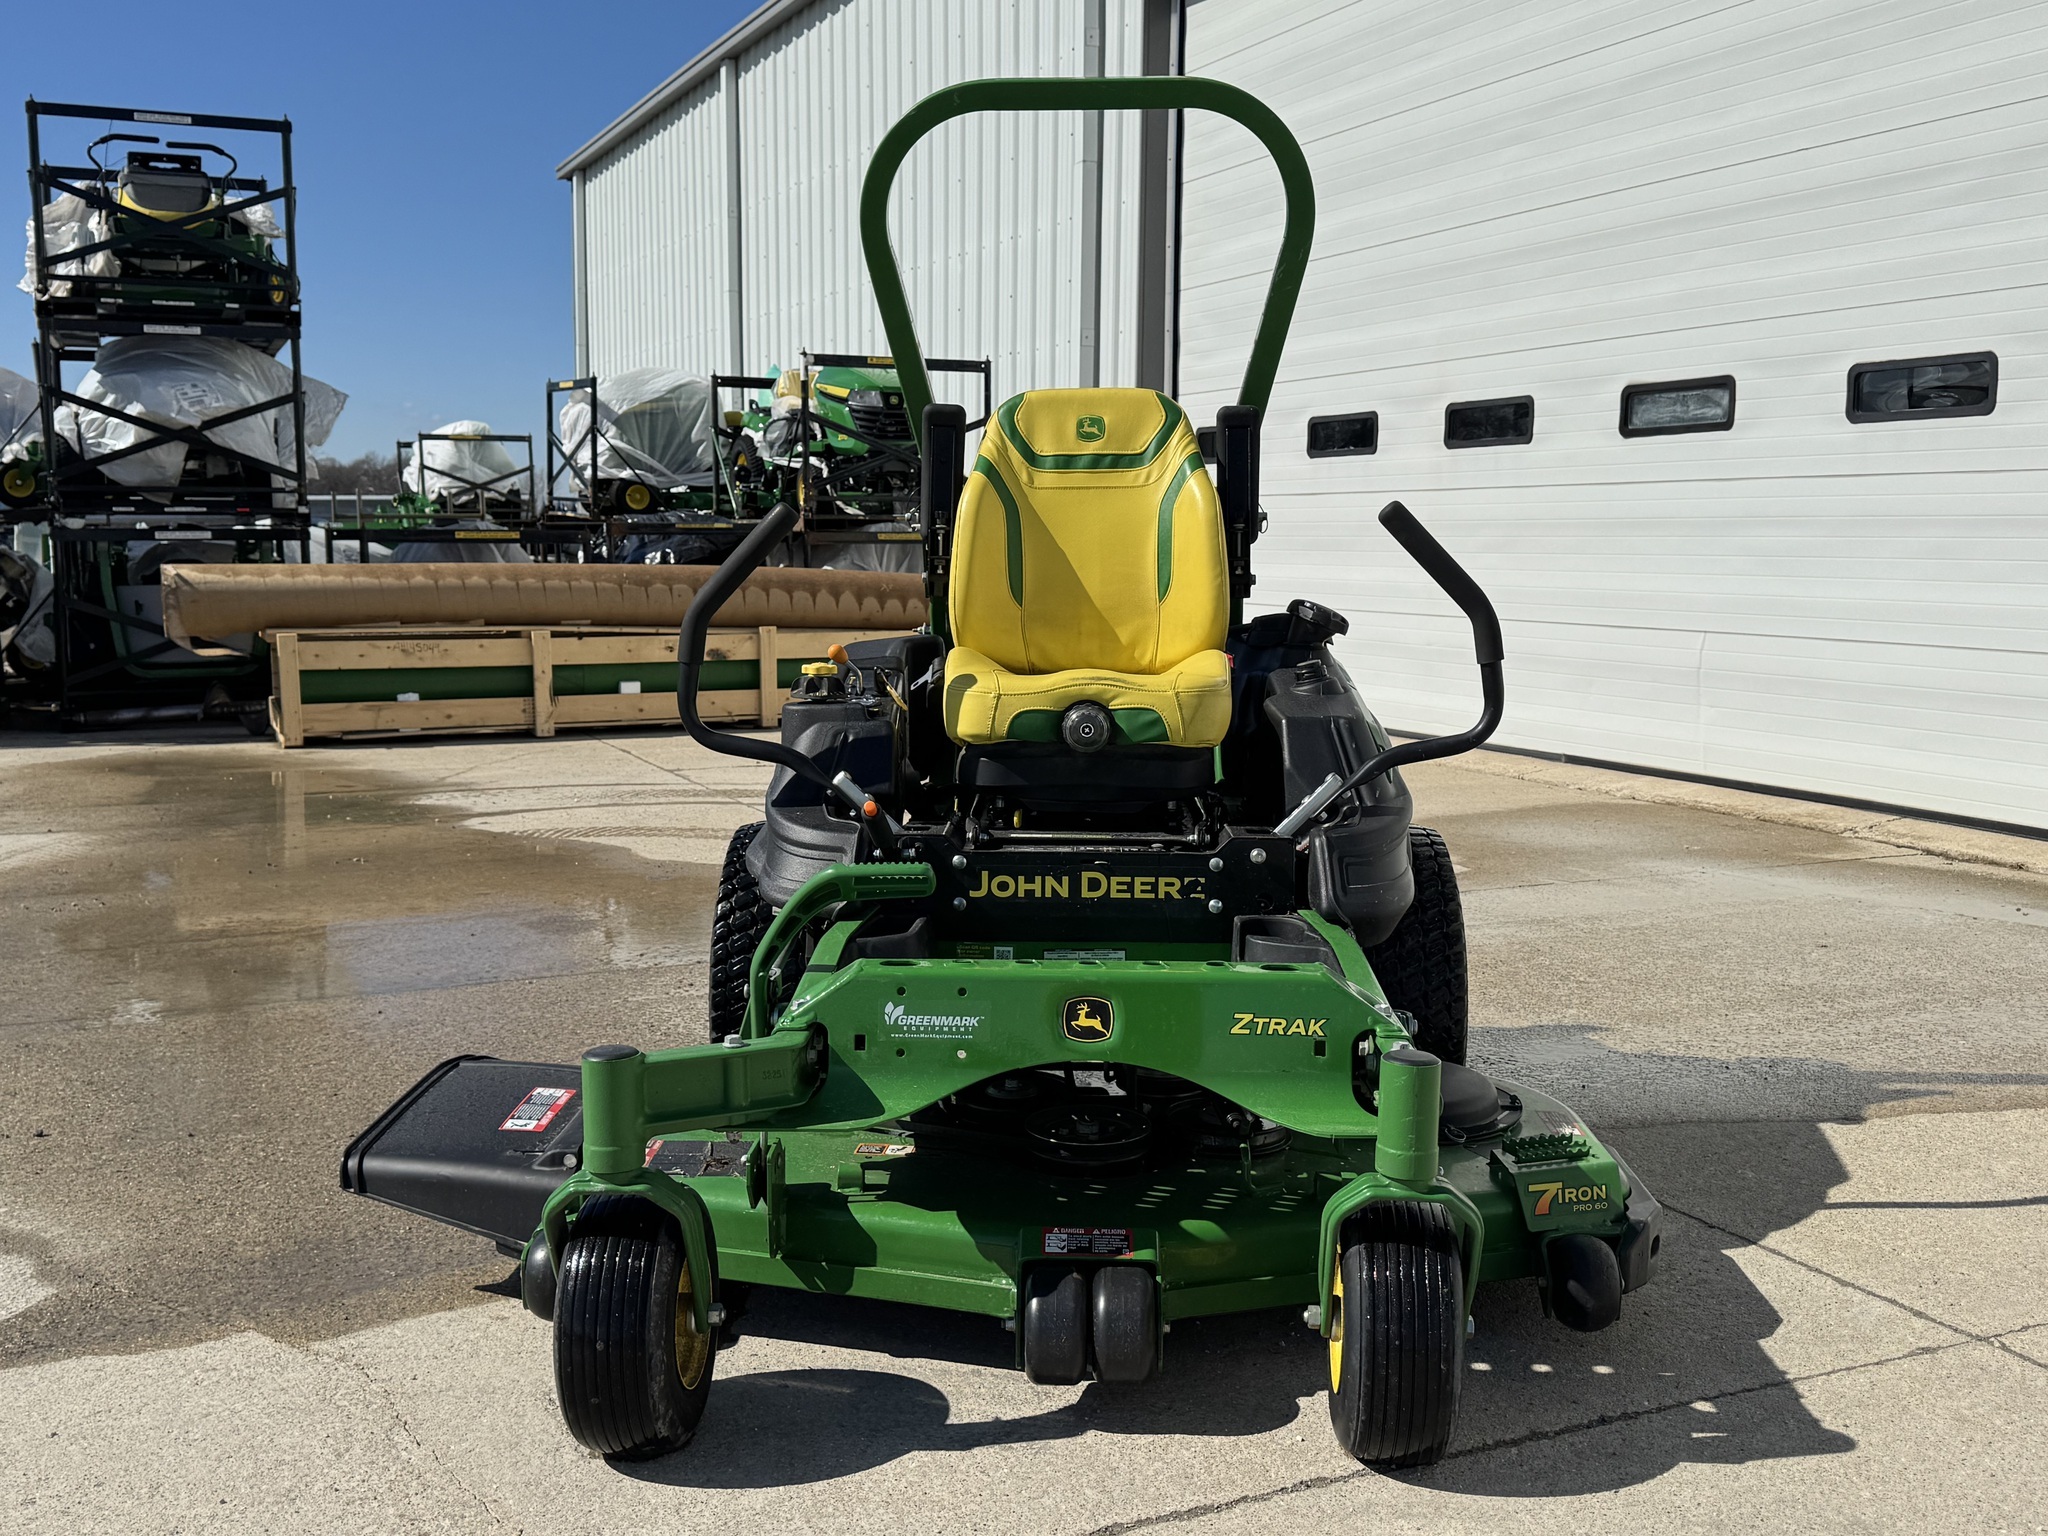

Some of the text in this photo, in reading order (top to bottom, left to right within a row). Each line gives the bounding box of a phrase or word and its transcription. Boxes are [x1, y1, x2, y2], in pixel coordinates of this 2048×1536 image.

[968, 870, 1069, 898] JOHN
[897, 1015, 980, 1027] GREENMARK
[1229, 1012, 1328, 1037] ZTRAK
[1573, 1201, 1608, 1212] PRO 60
